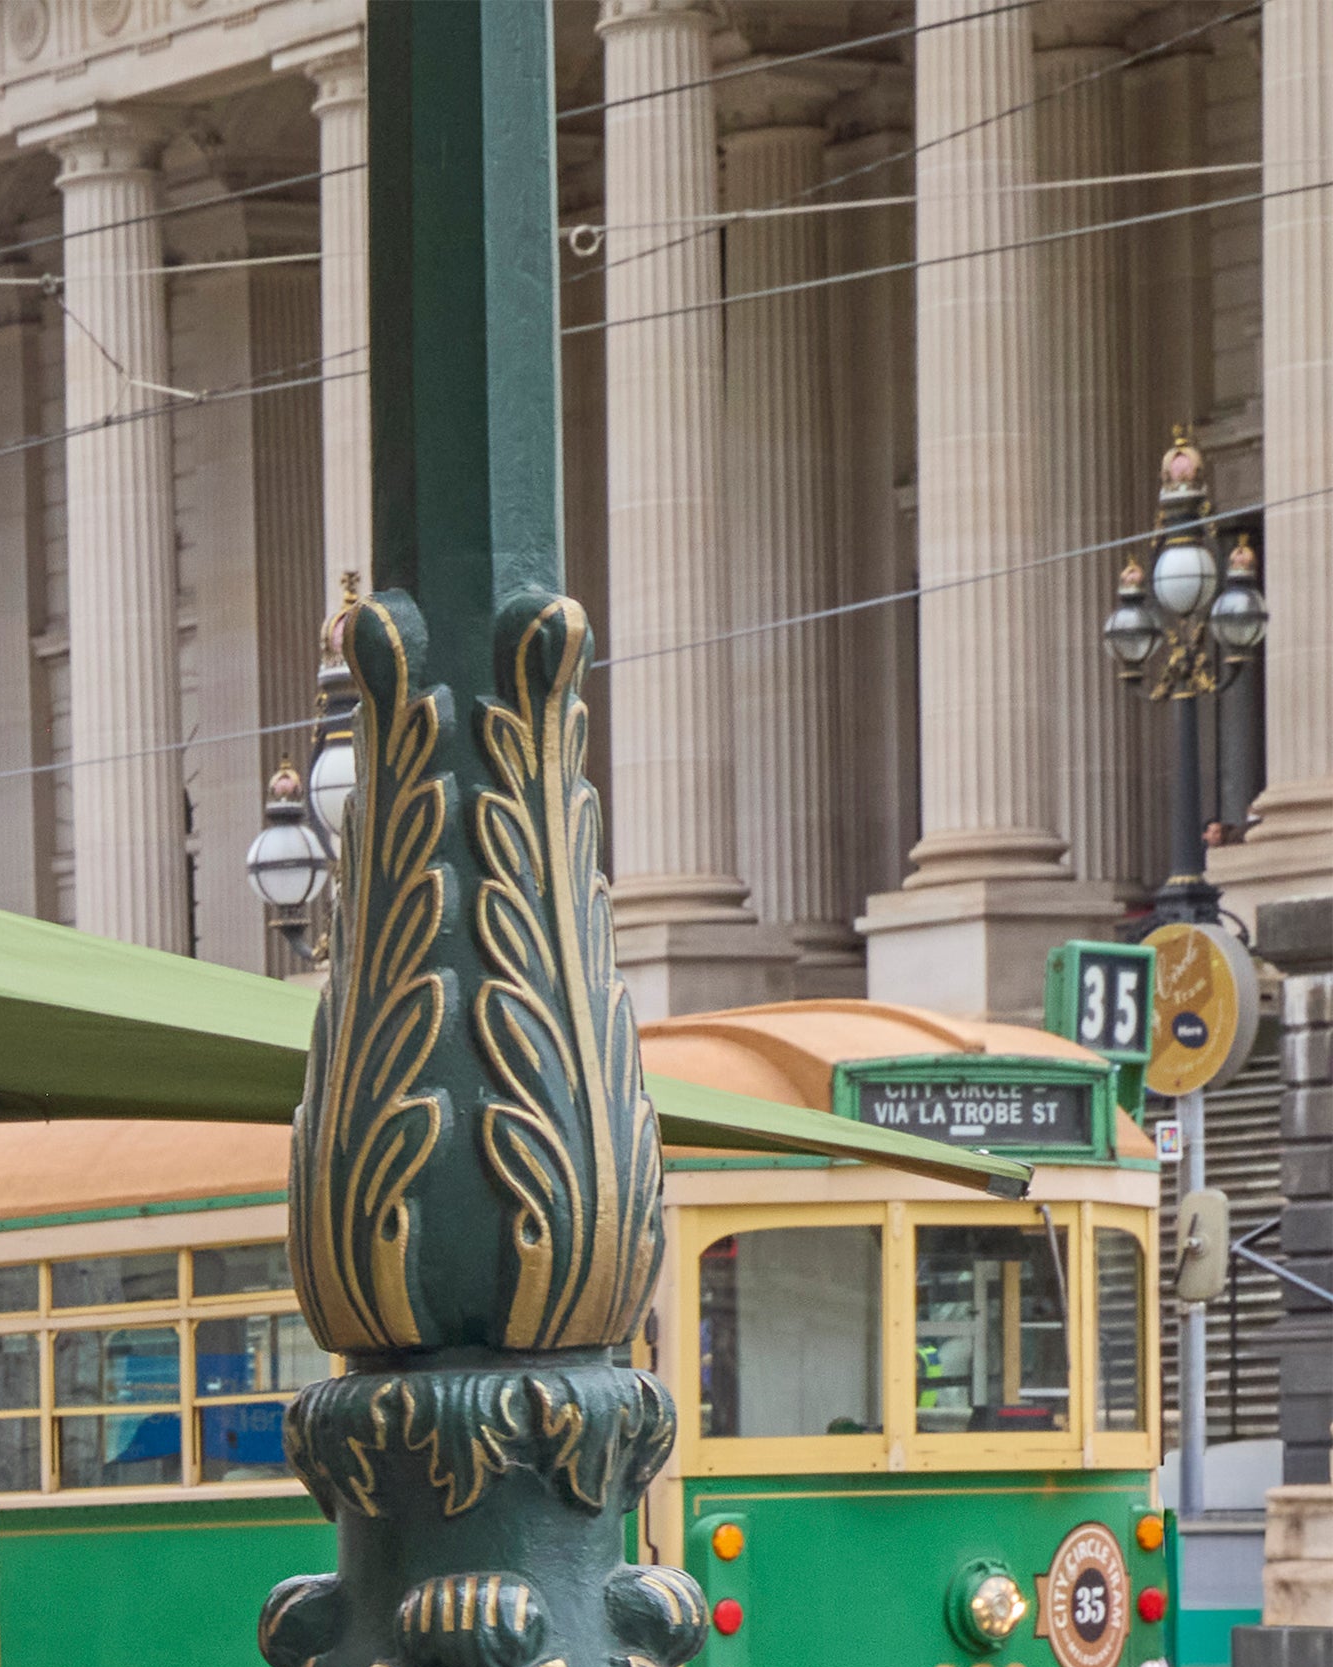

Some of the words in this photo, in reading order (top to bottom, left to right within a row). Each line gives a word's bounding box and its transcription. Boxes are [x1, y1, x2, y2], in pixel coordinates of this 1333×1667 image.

[1081, 964, 1138, 1045] 35
[874, 1102, 910, 1125] VIA
[919, 1102, 947, 1125] LA
[951, 1102, 1023, 1125] TROBE
[1032, 1102, 1059, 1124] ST
[1053, 1570, 1071, 1629] CITY
[1064, 1537, 1110, 1573] CIRCLE
[1107, 1556, 1123, 1628] TRAM
[1074, 1585, 1106, 1625] 35
